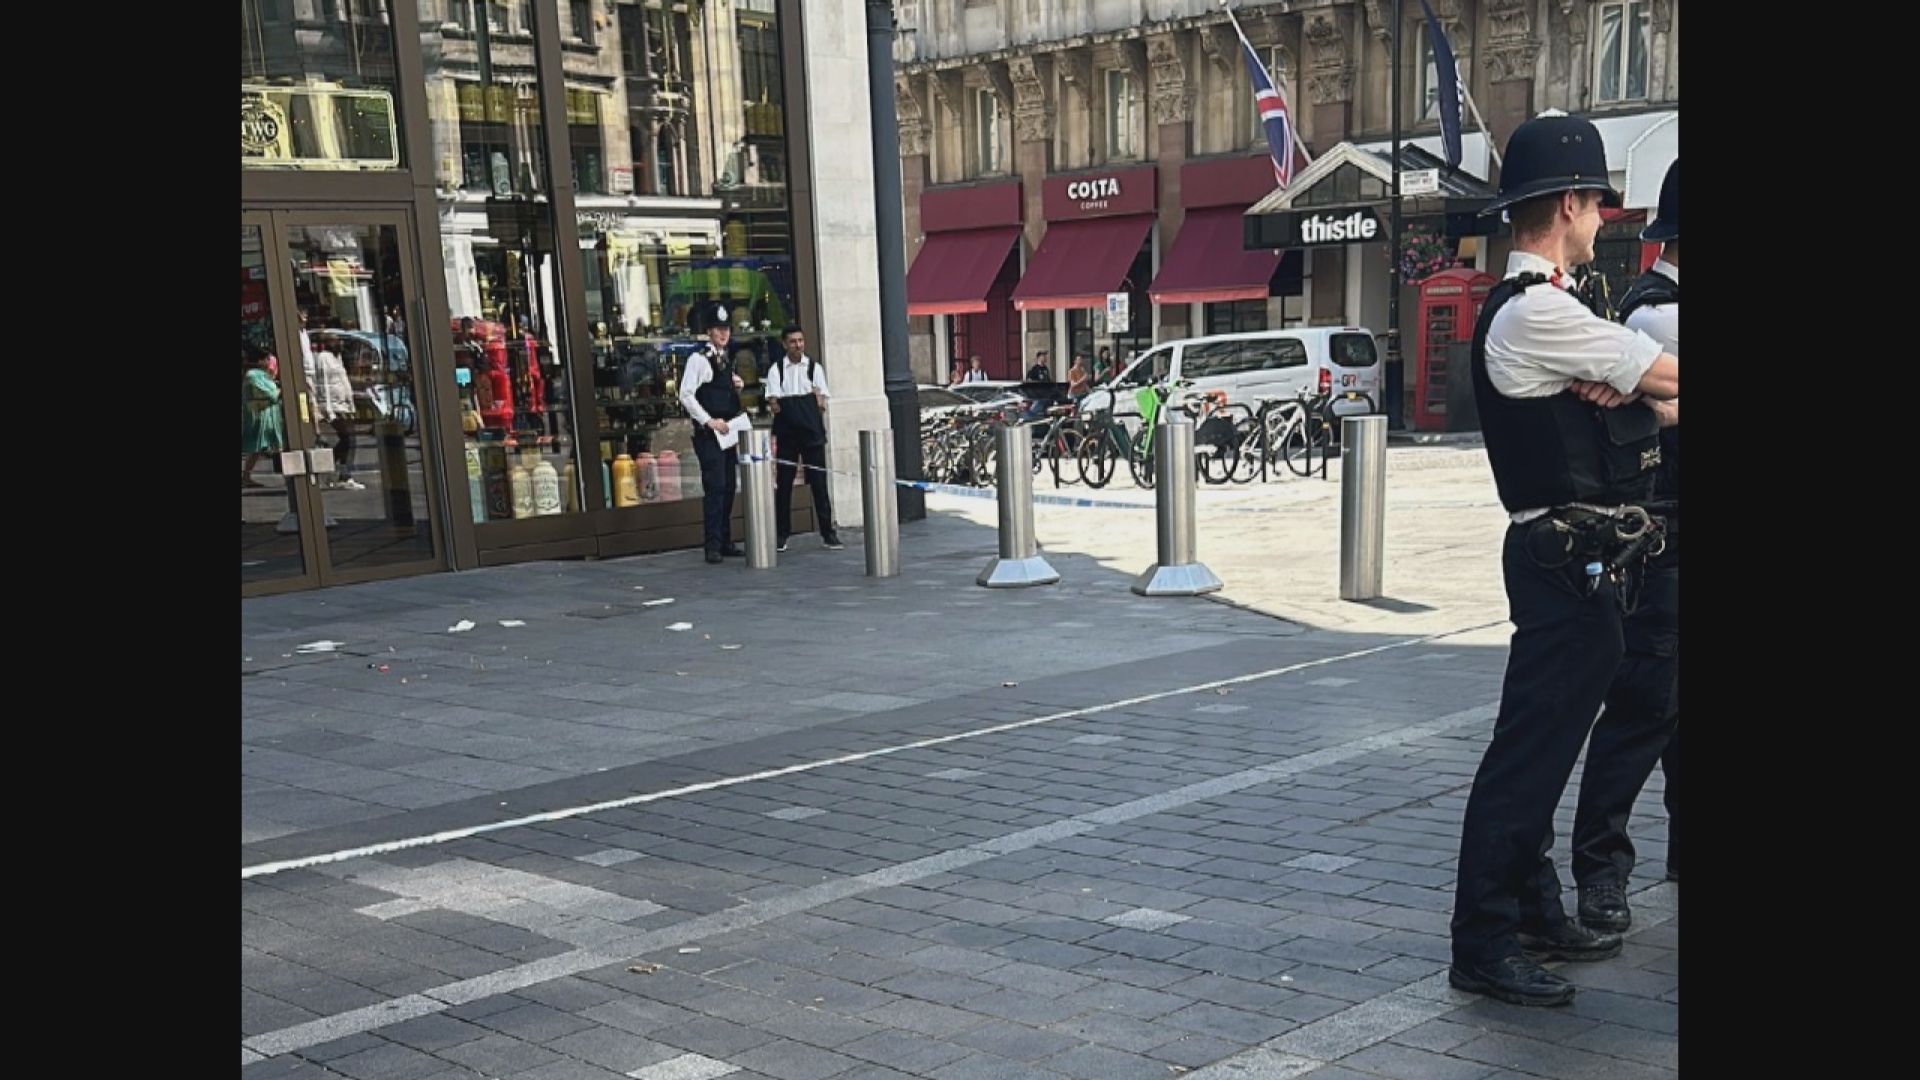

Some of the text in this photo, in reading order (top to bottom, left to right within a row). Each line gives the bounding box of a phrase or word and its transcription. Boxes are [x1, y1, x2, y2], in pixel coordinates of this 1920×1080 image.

[1067, 178, 1120, 200] COSTA
[1081, 200, 1108, 210] COFFEE
[1301, 211, 1378, 243] thistle
